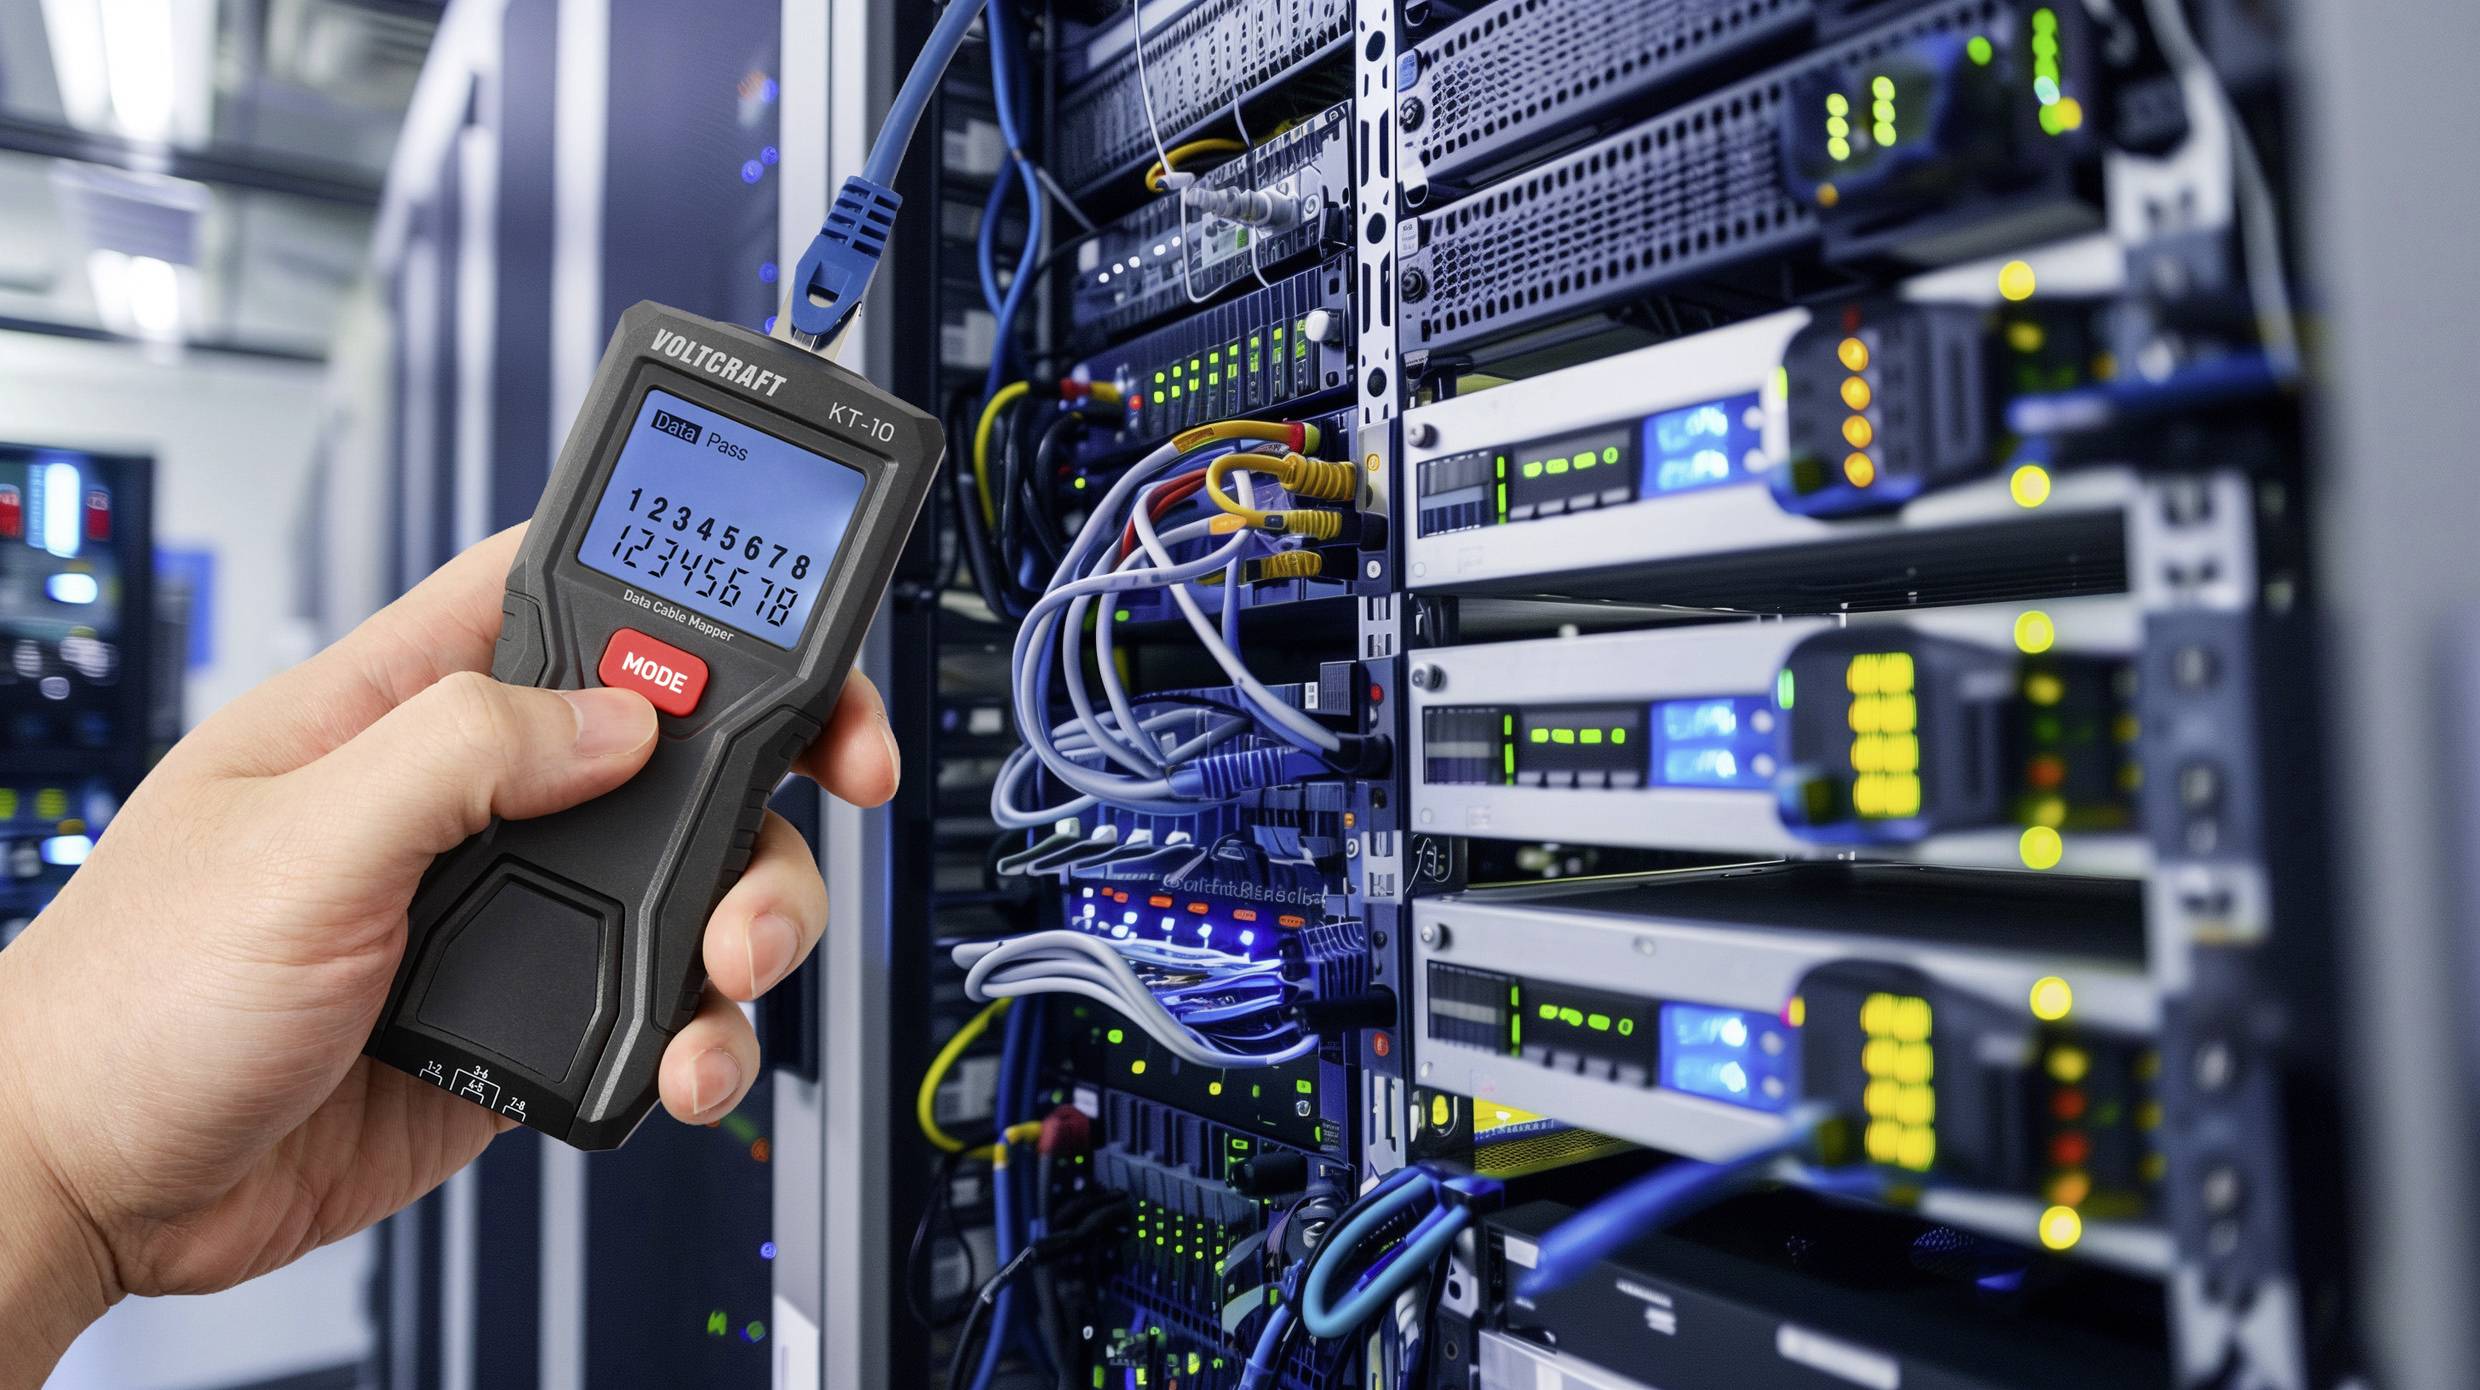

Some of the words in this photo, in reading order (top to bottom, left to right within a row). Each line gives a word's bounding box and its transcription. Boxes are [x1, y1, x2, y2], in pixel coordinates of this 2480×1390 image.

[650, 328, 787, 397] VOLTCRAFT
[655, 411, 698, 443] Data
[706, 432, 749, 462] Pass
[828, 402, 895, 443] KT-10
[623, 588, 651, 609] Data
[652, 601, 686, 624] Cable
[688, 616, 734, 642] Mapper
[621, 651, 688, 694] MODE
[428, 1060, 443, 1075] 1-2
[468, 1079, 484, 1093] 4-5
[473, 1065, 489, 1080] 3-6
[510, 1096, 526, 1111] 7-8
